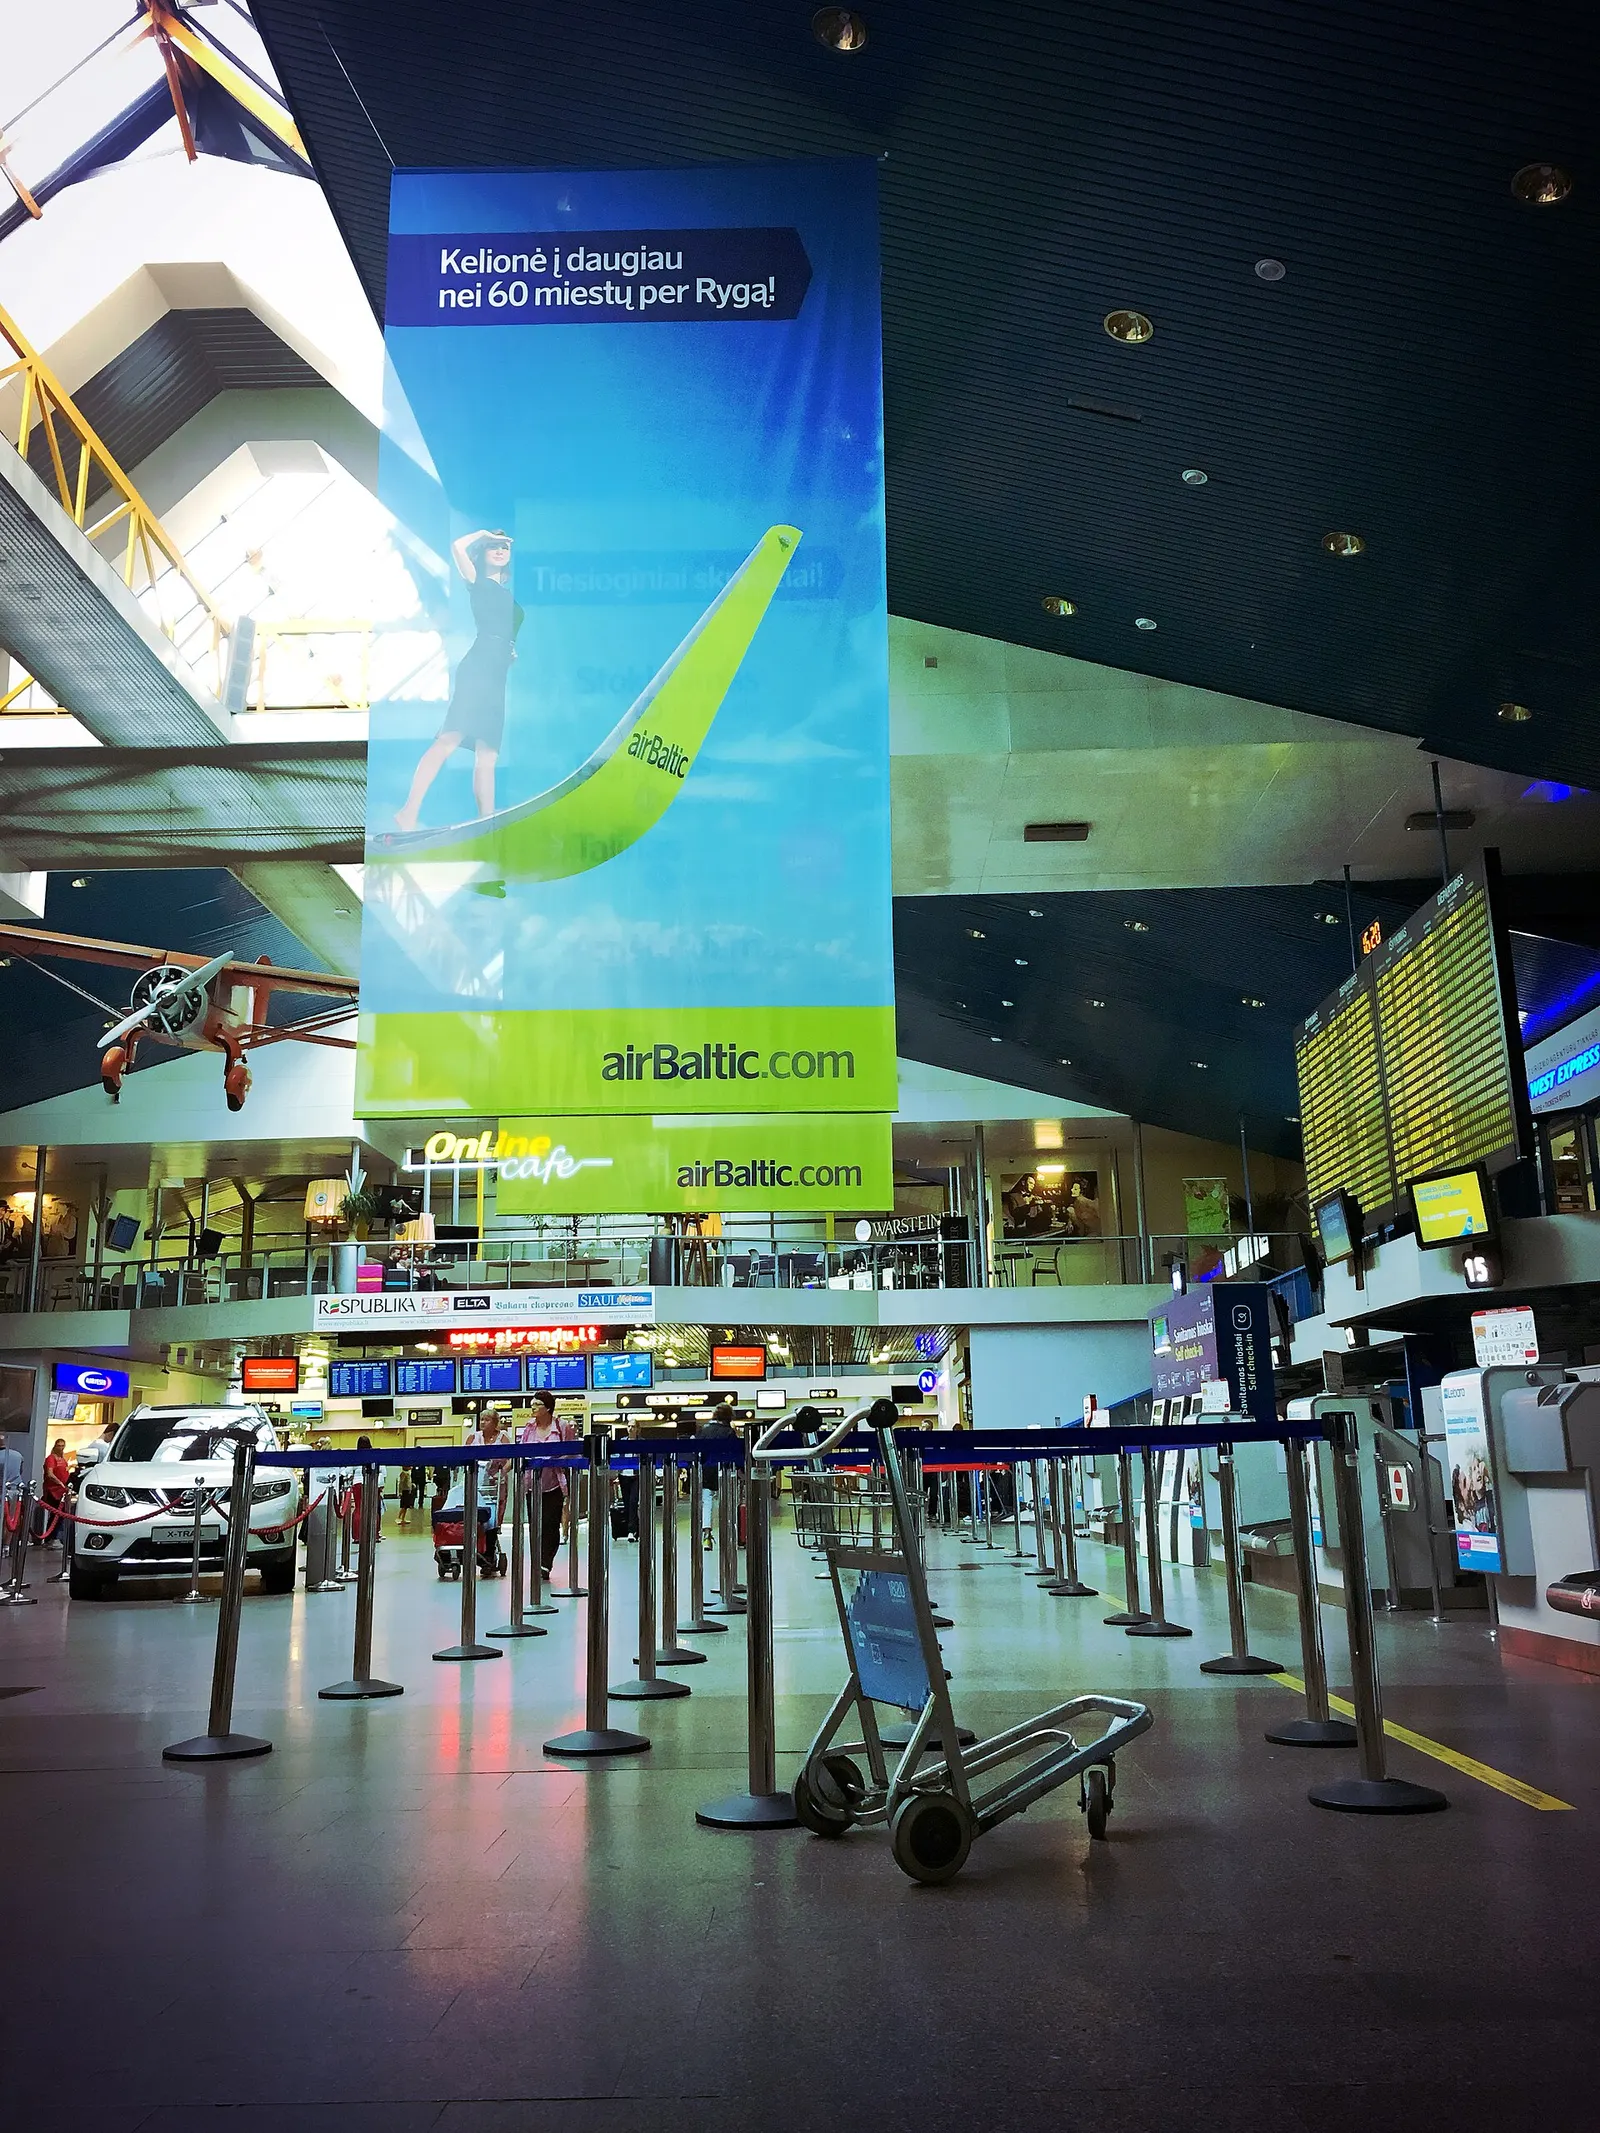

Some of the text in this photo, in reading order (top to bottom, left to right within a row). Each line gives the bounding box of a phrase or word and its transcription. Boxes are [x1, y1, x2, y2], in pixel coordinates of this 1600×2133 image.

[440, 246, 683, 278] Kelionė į daugiau
[439, 276, 775, 310] nei 60 miestų per Rygą!
[627, 730, 688, 778] airBaltic
[601, 1043, 855, 1081] airBaltic.com
[1529, 1043, 1600, 1099] WEST EXPRESS
[424, 1129, 552, 1161] OnLine
[500, 1144, 583, 1185] cafe
[676, 1160, 862, 1187] airBaltic.com
[1464, 1257, 1489, 1283] 15
[457, 1299, 488, 1308] ELTA
[450, 1326, 598, 1344] www.skrendu.lt
[1233, 1333, 1249, 1415] Savitarnos kioskai
[1245, 1333, 1257, 1391] Self check-in
[921, 1375, 933, 1388] N
[167, 1530, 205, 1538] X-TRAL
